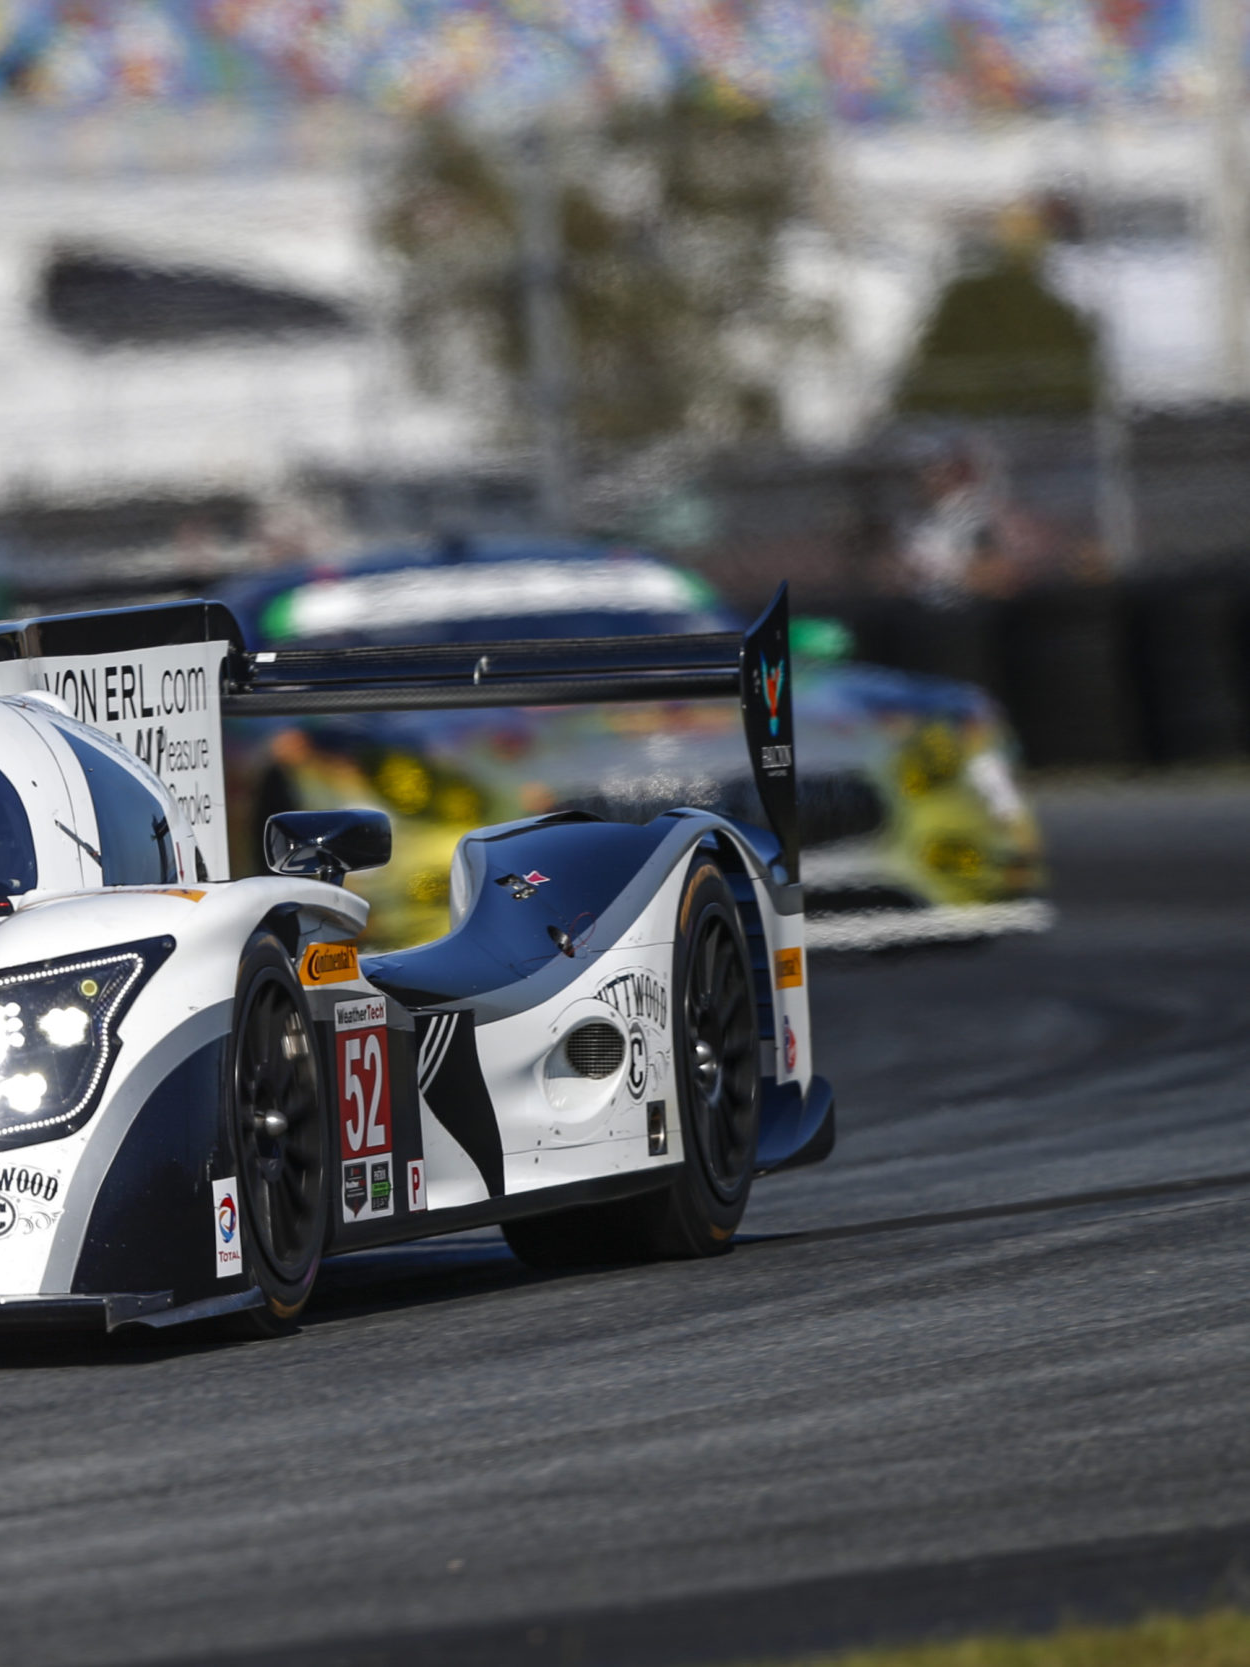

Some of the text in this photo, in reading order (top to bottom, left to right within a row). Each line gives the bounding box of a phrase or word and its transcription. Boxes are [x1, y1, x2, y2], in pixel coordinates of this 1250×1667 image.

[337, 1003, 384, 1024] WeatherTech
[344, 1034, 386, 1151] 52
[411, 1166, 421, 1205] P
[218, 1250, 241, 1263] TOTAL
